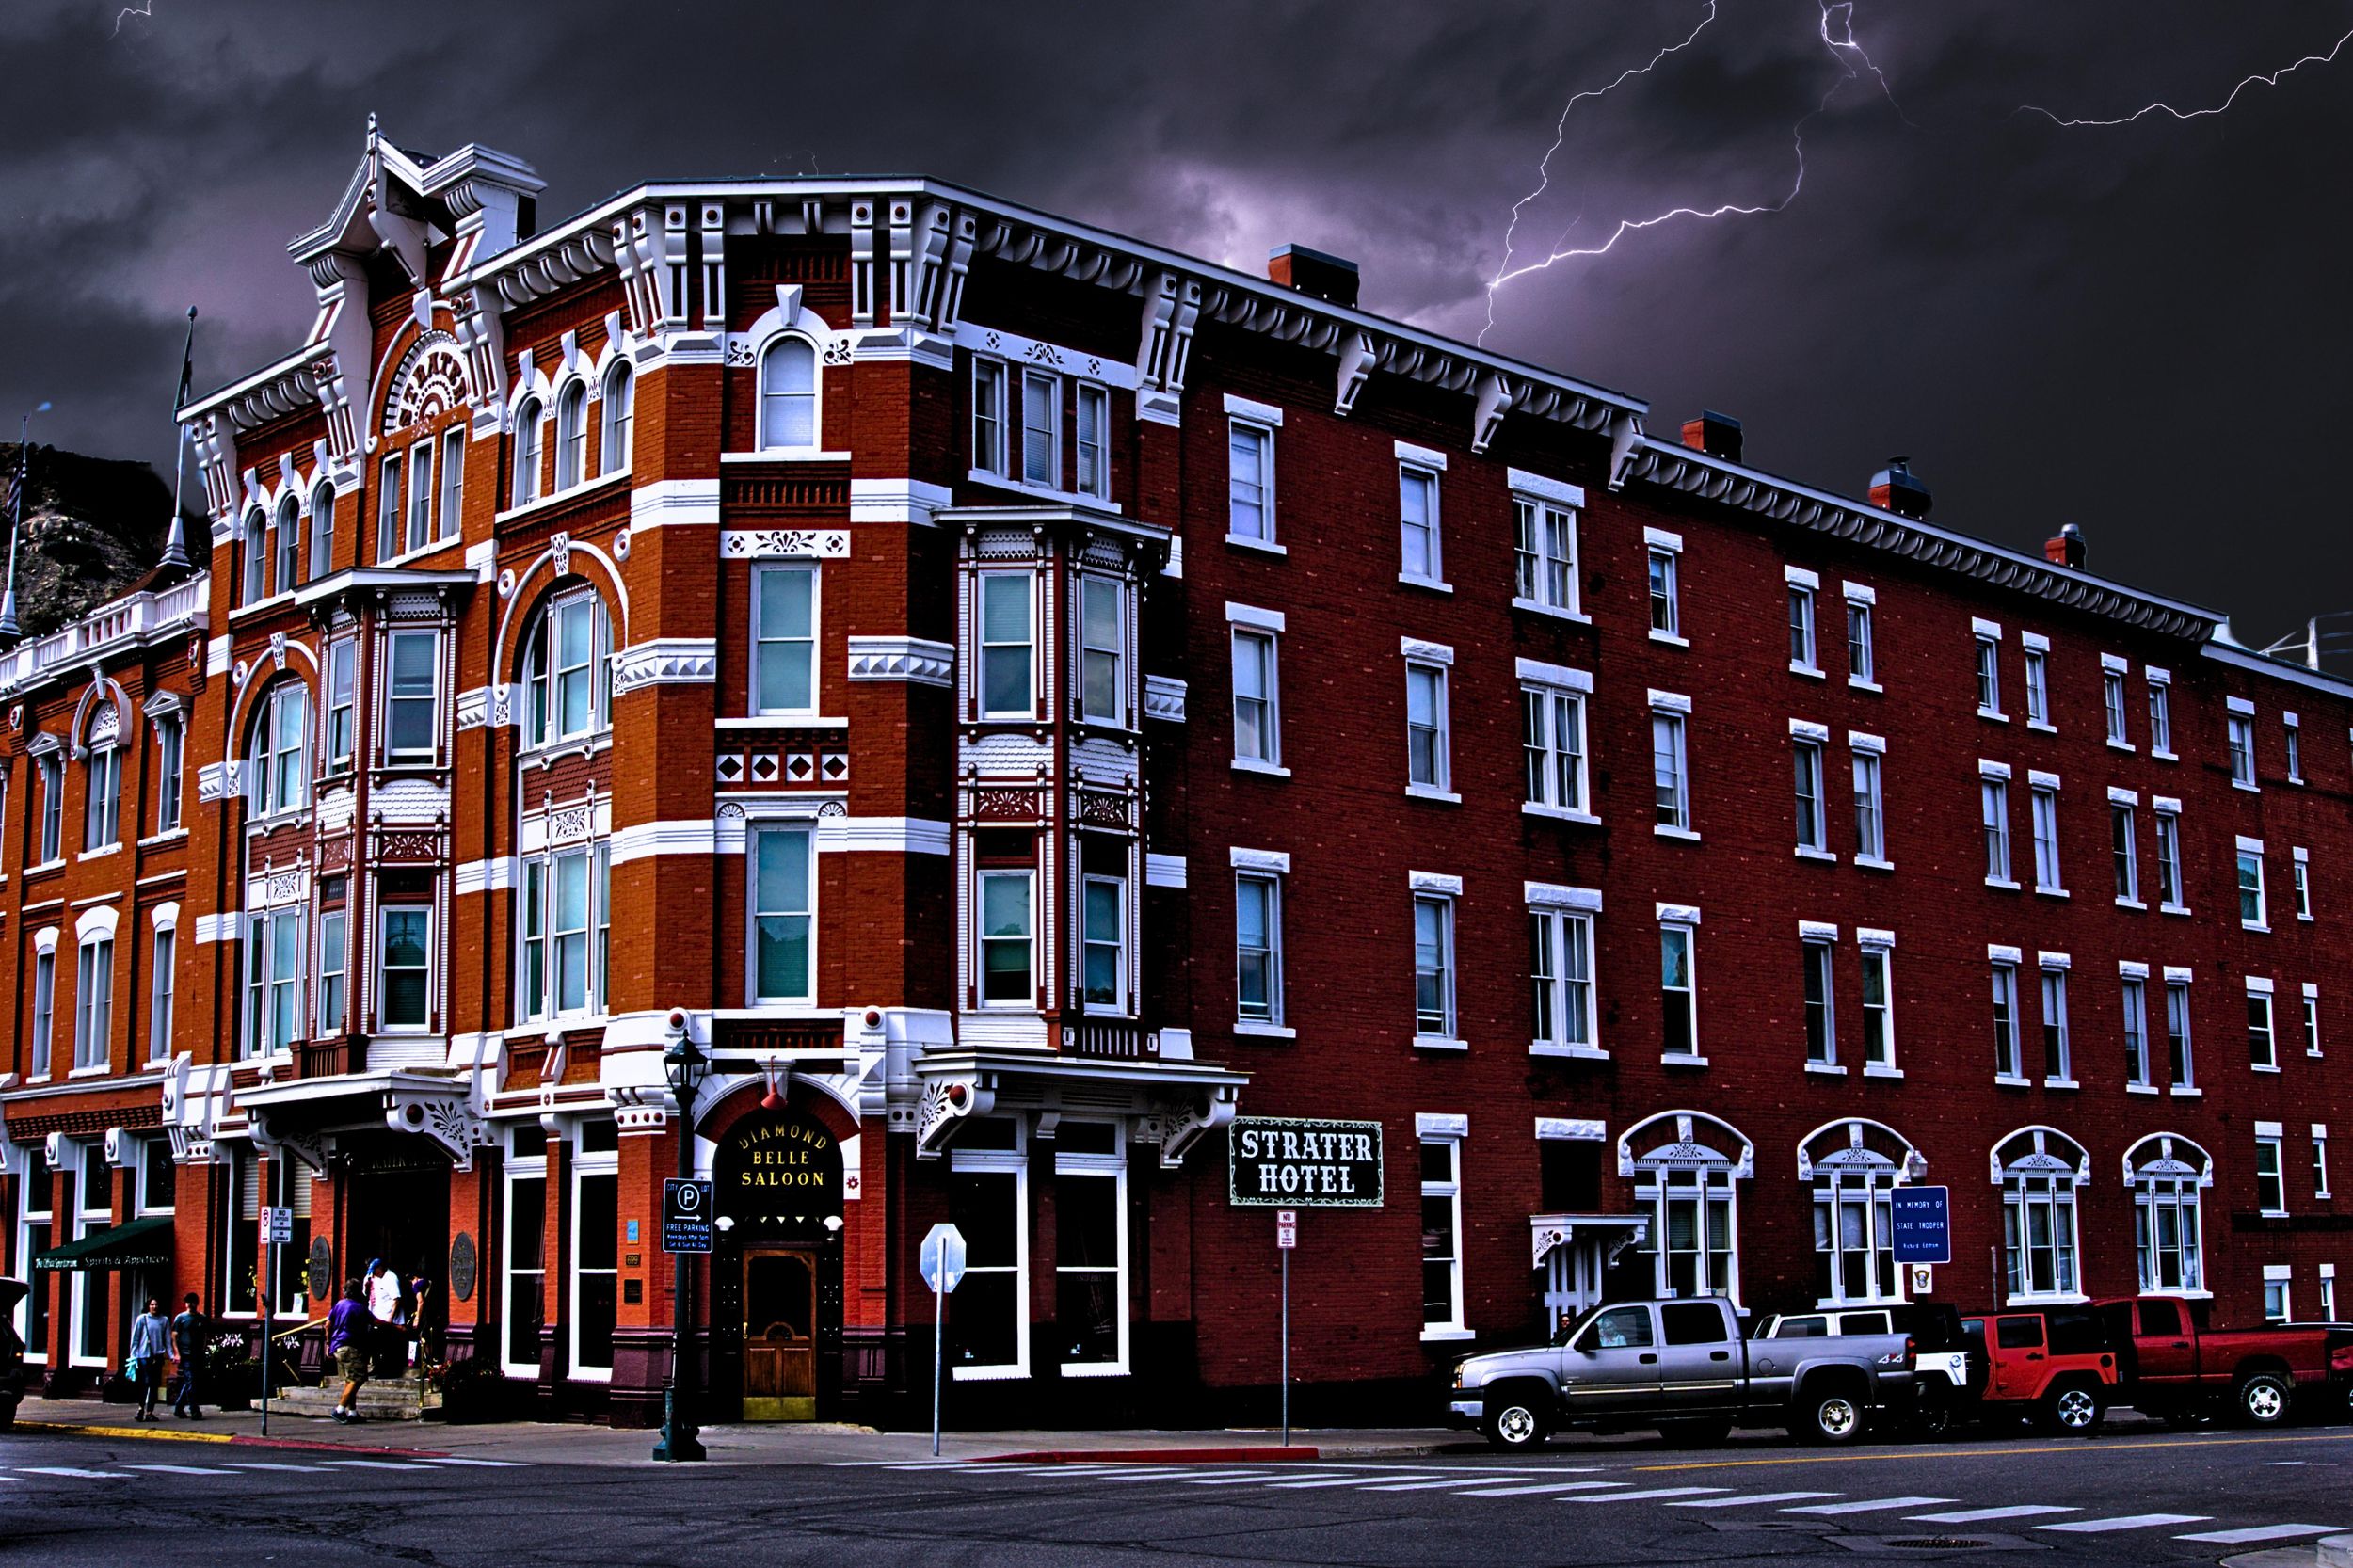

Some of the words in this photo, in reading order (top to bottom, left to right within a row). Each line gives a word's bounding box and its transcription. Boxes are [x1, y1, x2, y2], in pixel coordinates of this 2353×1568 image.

[398, 351, 467, 427] STRATER
[739, 1124, 826, 1149] DIAMOND
[1241, 1130, 1373, 1161] STRATER
[753, 1151, 809, 1165] BELLE
[742, 1172, 824, 1186] SALOON
[1258, 1164, 1355, 1193] HOTEL
[684, 1190, 694, 1205] P
[666, 1224, 681, 1232] FREE
[85, 1256, 112, 1267] Spirits
[114, 1256, 121, 1265] &
